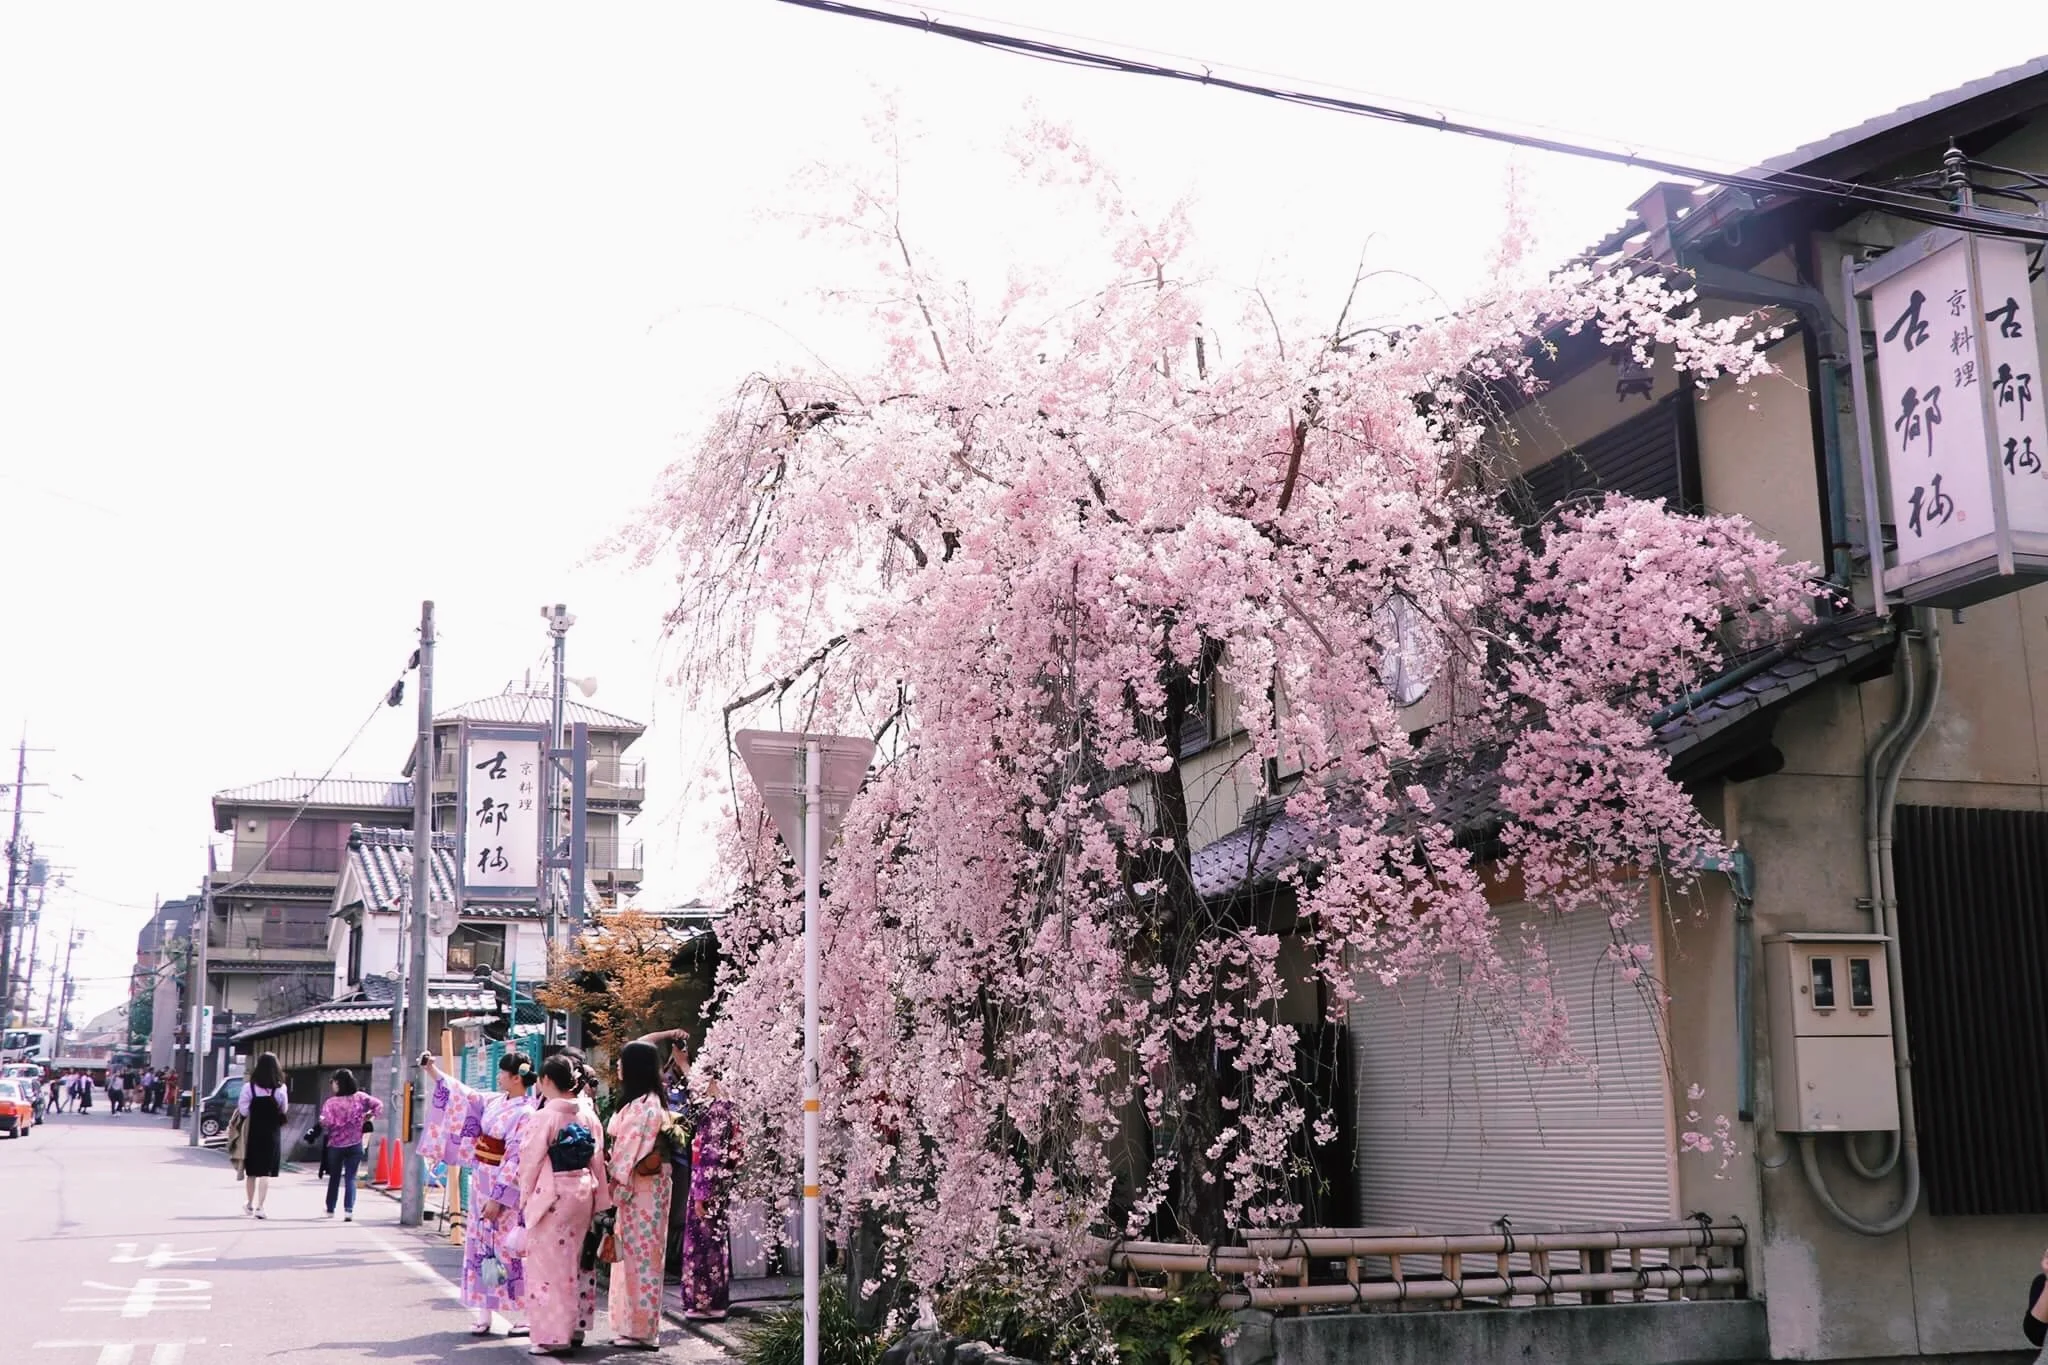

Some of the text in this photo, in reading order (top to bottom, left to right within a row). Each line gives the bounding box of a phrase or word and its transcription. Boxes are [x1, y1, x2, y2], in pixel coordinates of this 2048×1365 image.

[1946, 288, 1978, 389] 京料理
[1985, 296, 2042, 476] 古都梅
[1883, 290, 1954, 538] 古都梅
[475, 750, 510, 874] 古都梅
[518, 761, 534, 812] 京料理
